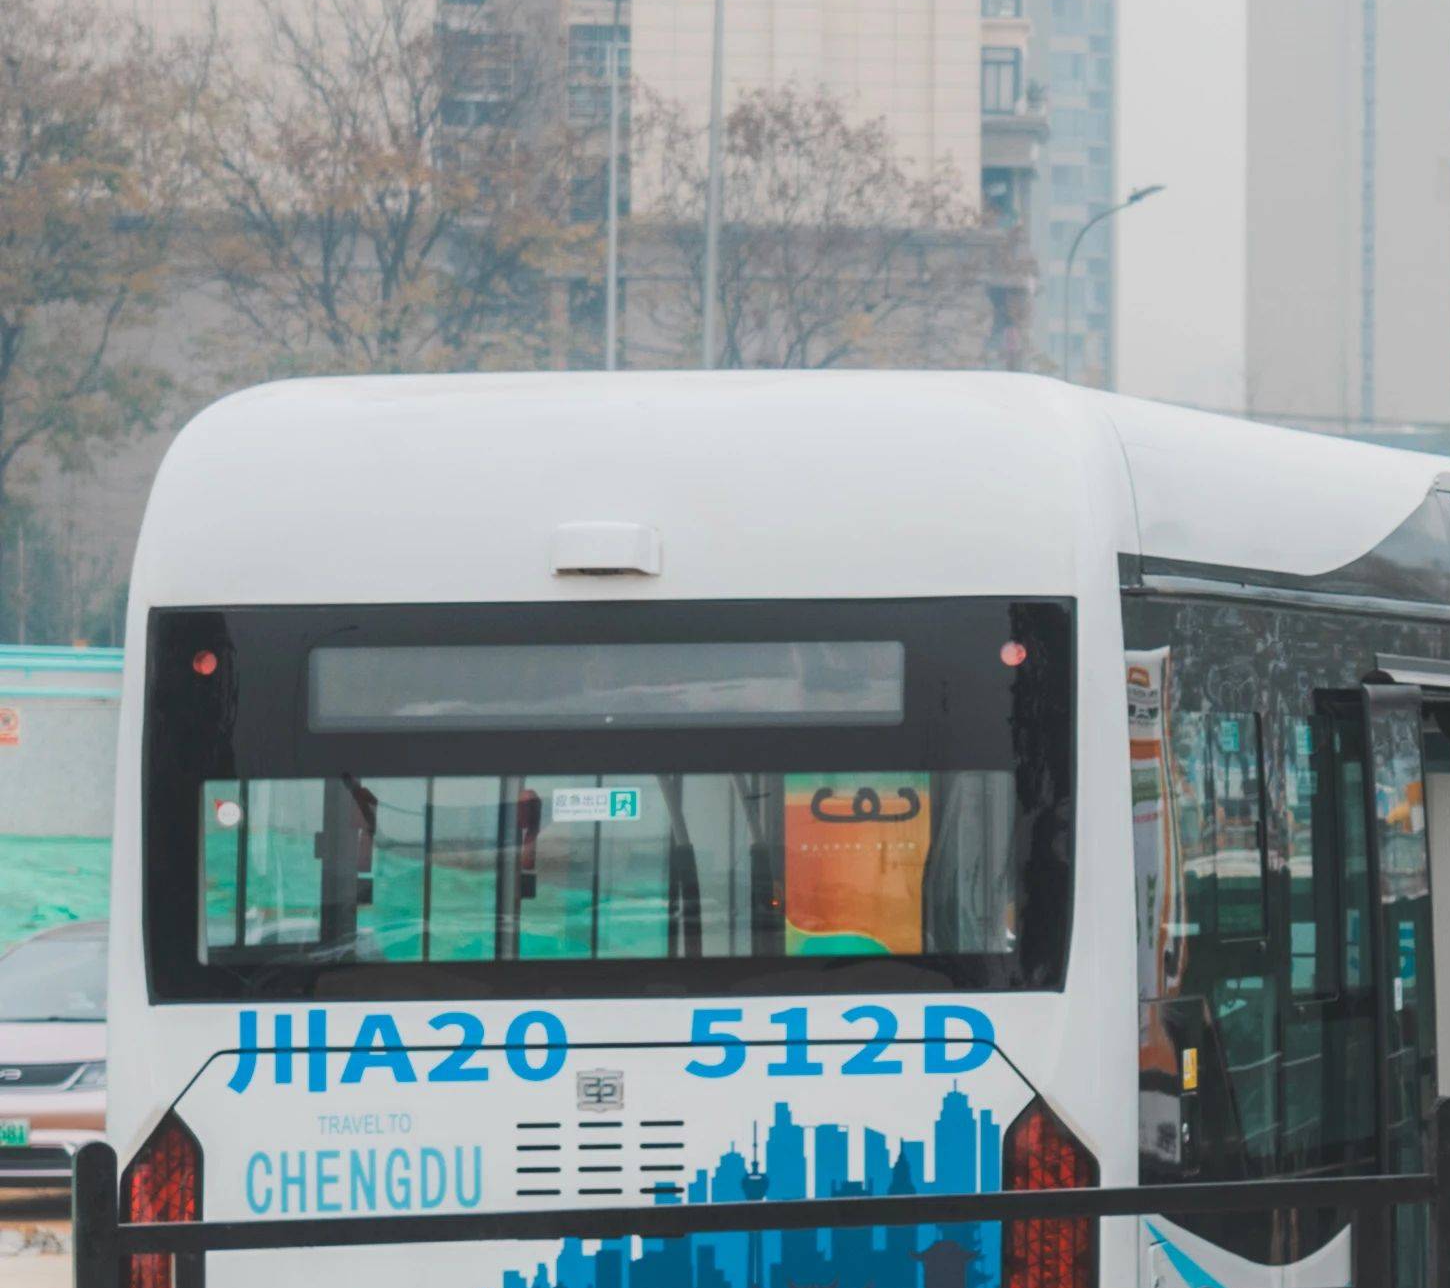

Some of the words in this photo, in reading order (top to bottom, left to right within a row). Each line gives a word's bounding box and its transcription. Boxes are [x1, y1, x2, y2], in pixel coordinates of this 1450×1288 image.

[227, 1009, 568, 1094] 川A20
[684, 1005, 995, 1078] 512D
[318, 1114, 384, 1136] TRAVEL
[387, 1113, 412, 1134] TO
[246, 1145, 482, 1215] CHENGDU
